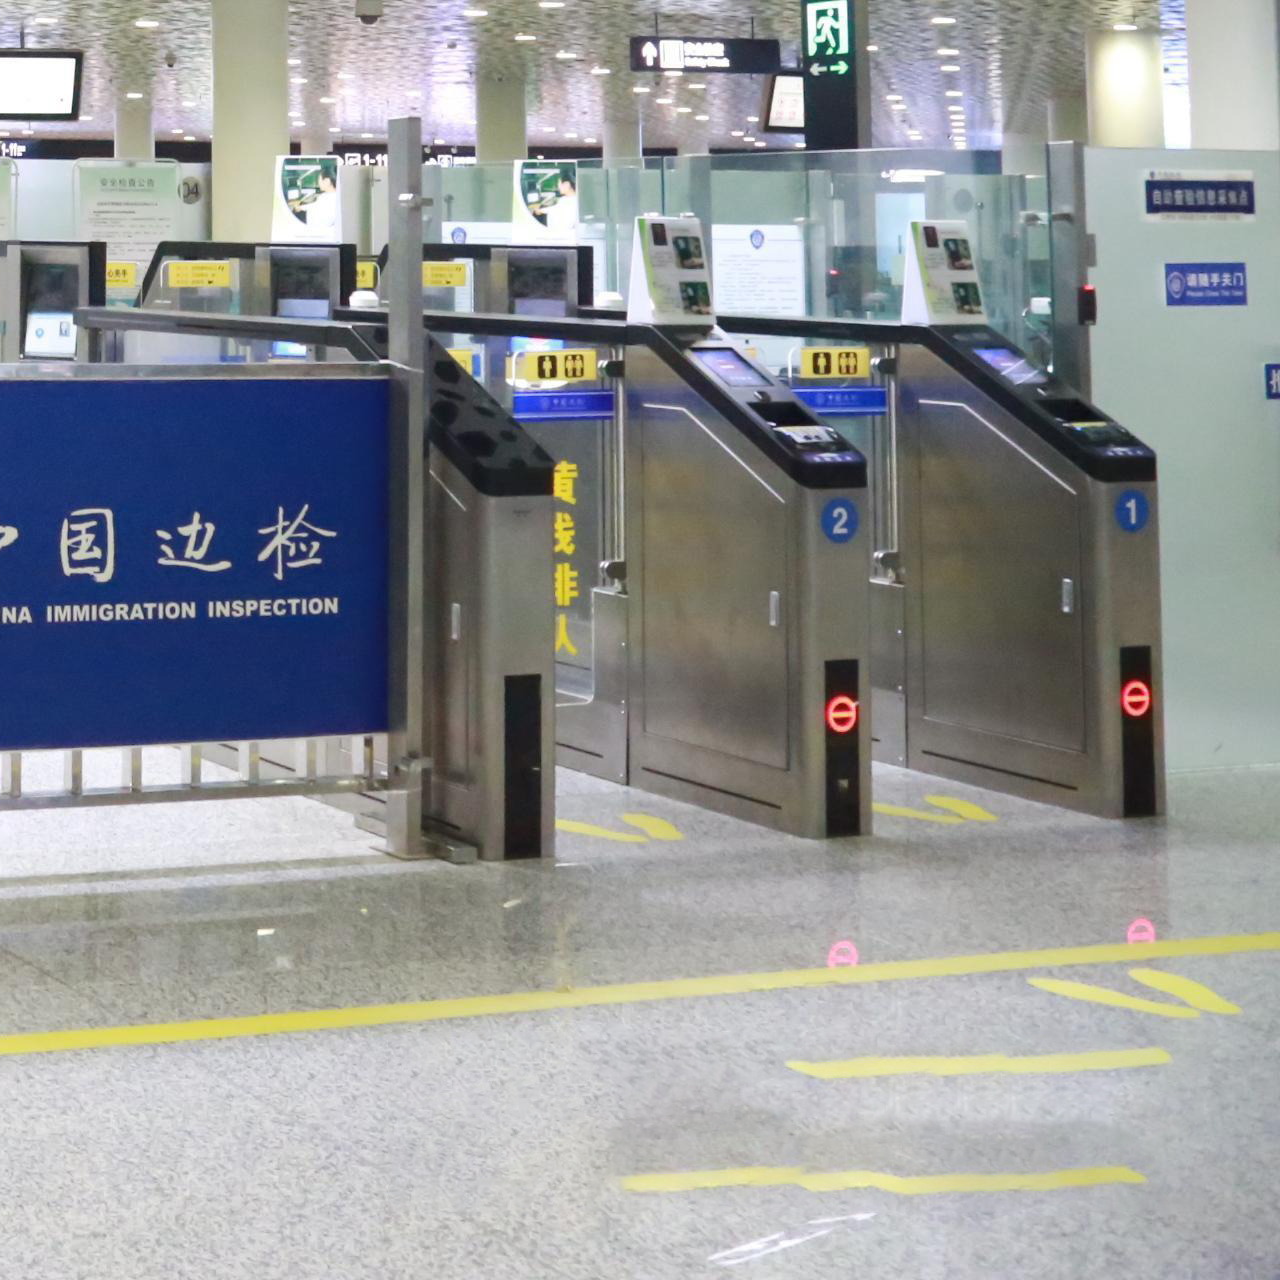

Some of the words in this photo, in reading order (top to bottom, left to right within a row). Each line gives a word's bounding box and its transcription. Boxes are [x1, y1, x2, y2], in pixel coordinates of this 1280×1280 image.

[182, 181, 200, 199] 04
[832, 507, 849, 535] 2
[1125, 498, 1138, 525] 1
[46, 601, 196, 623] IMMIGRATION
[208, 597, 339, 618] INSPECTION
